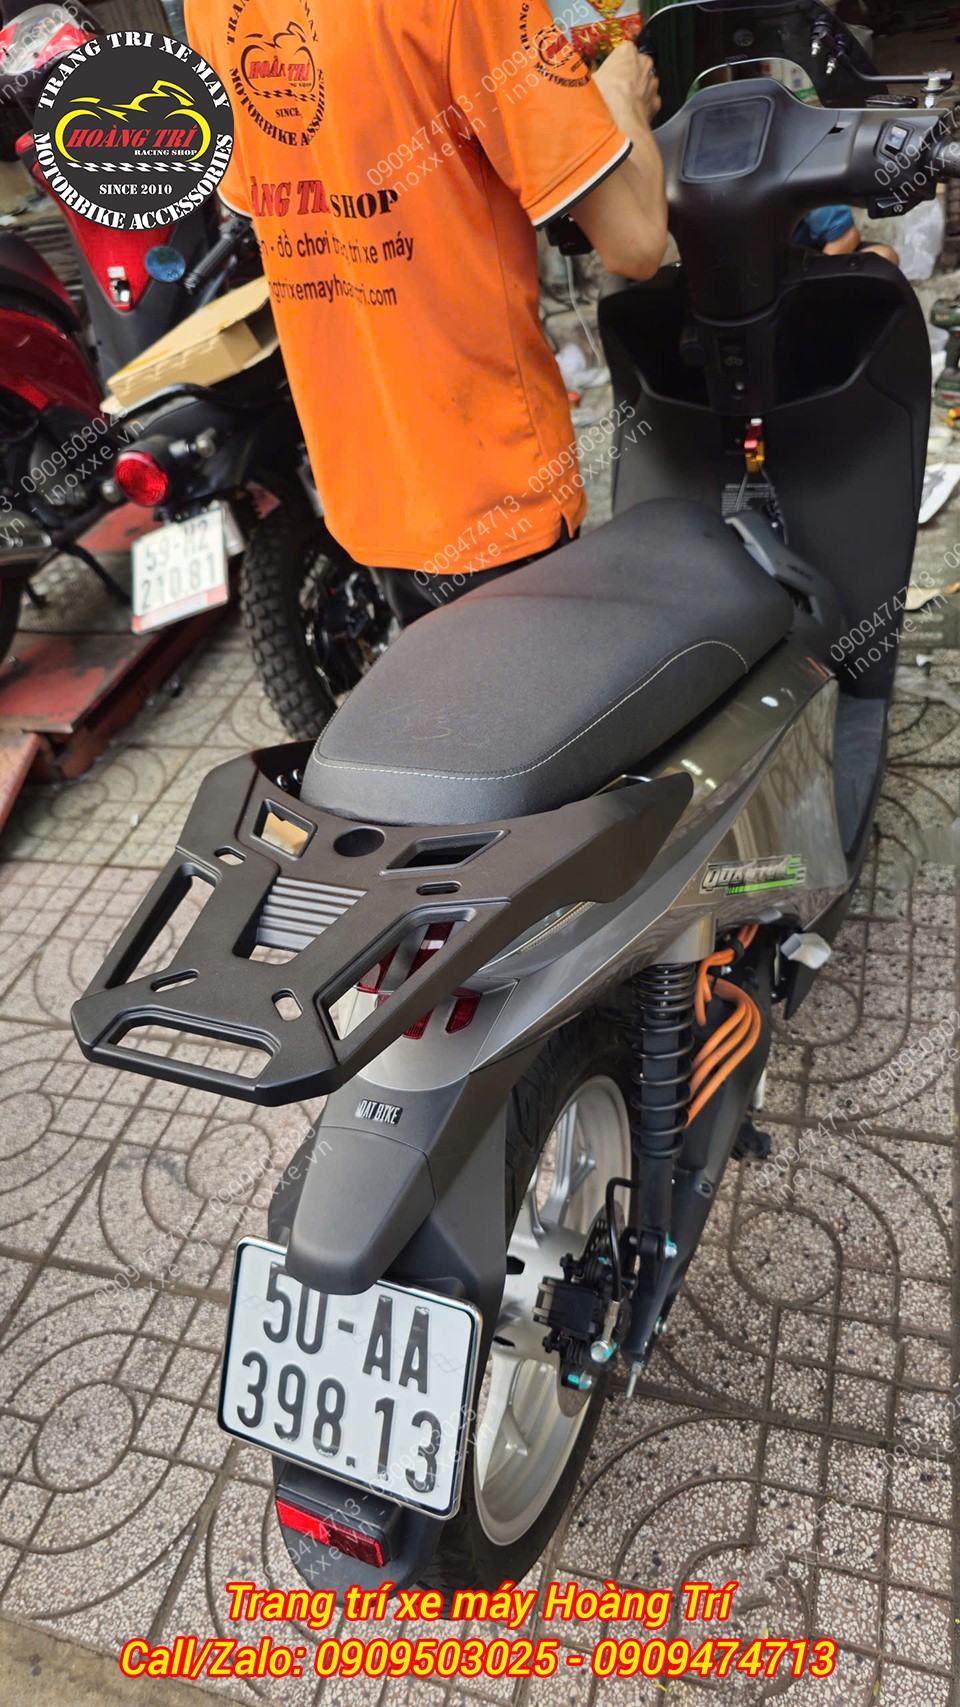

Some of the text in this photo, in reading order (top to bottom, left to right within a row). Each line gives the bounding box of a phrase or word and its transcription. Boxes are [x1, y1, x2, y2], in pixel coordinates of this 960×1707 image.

[229, 67, 298, 147] MOTORBIKE
[330, 189, 398, 219] SHOP
[277, 229, 293, 258] đồ
[296, 230, 331, 257] chơi
[363, 245, 379, 264] xe
[382, 231, 414, 261] máy
[373, 1103, 401, 1124] BIKE
[237, 1351, 442, 1493] 398.13
